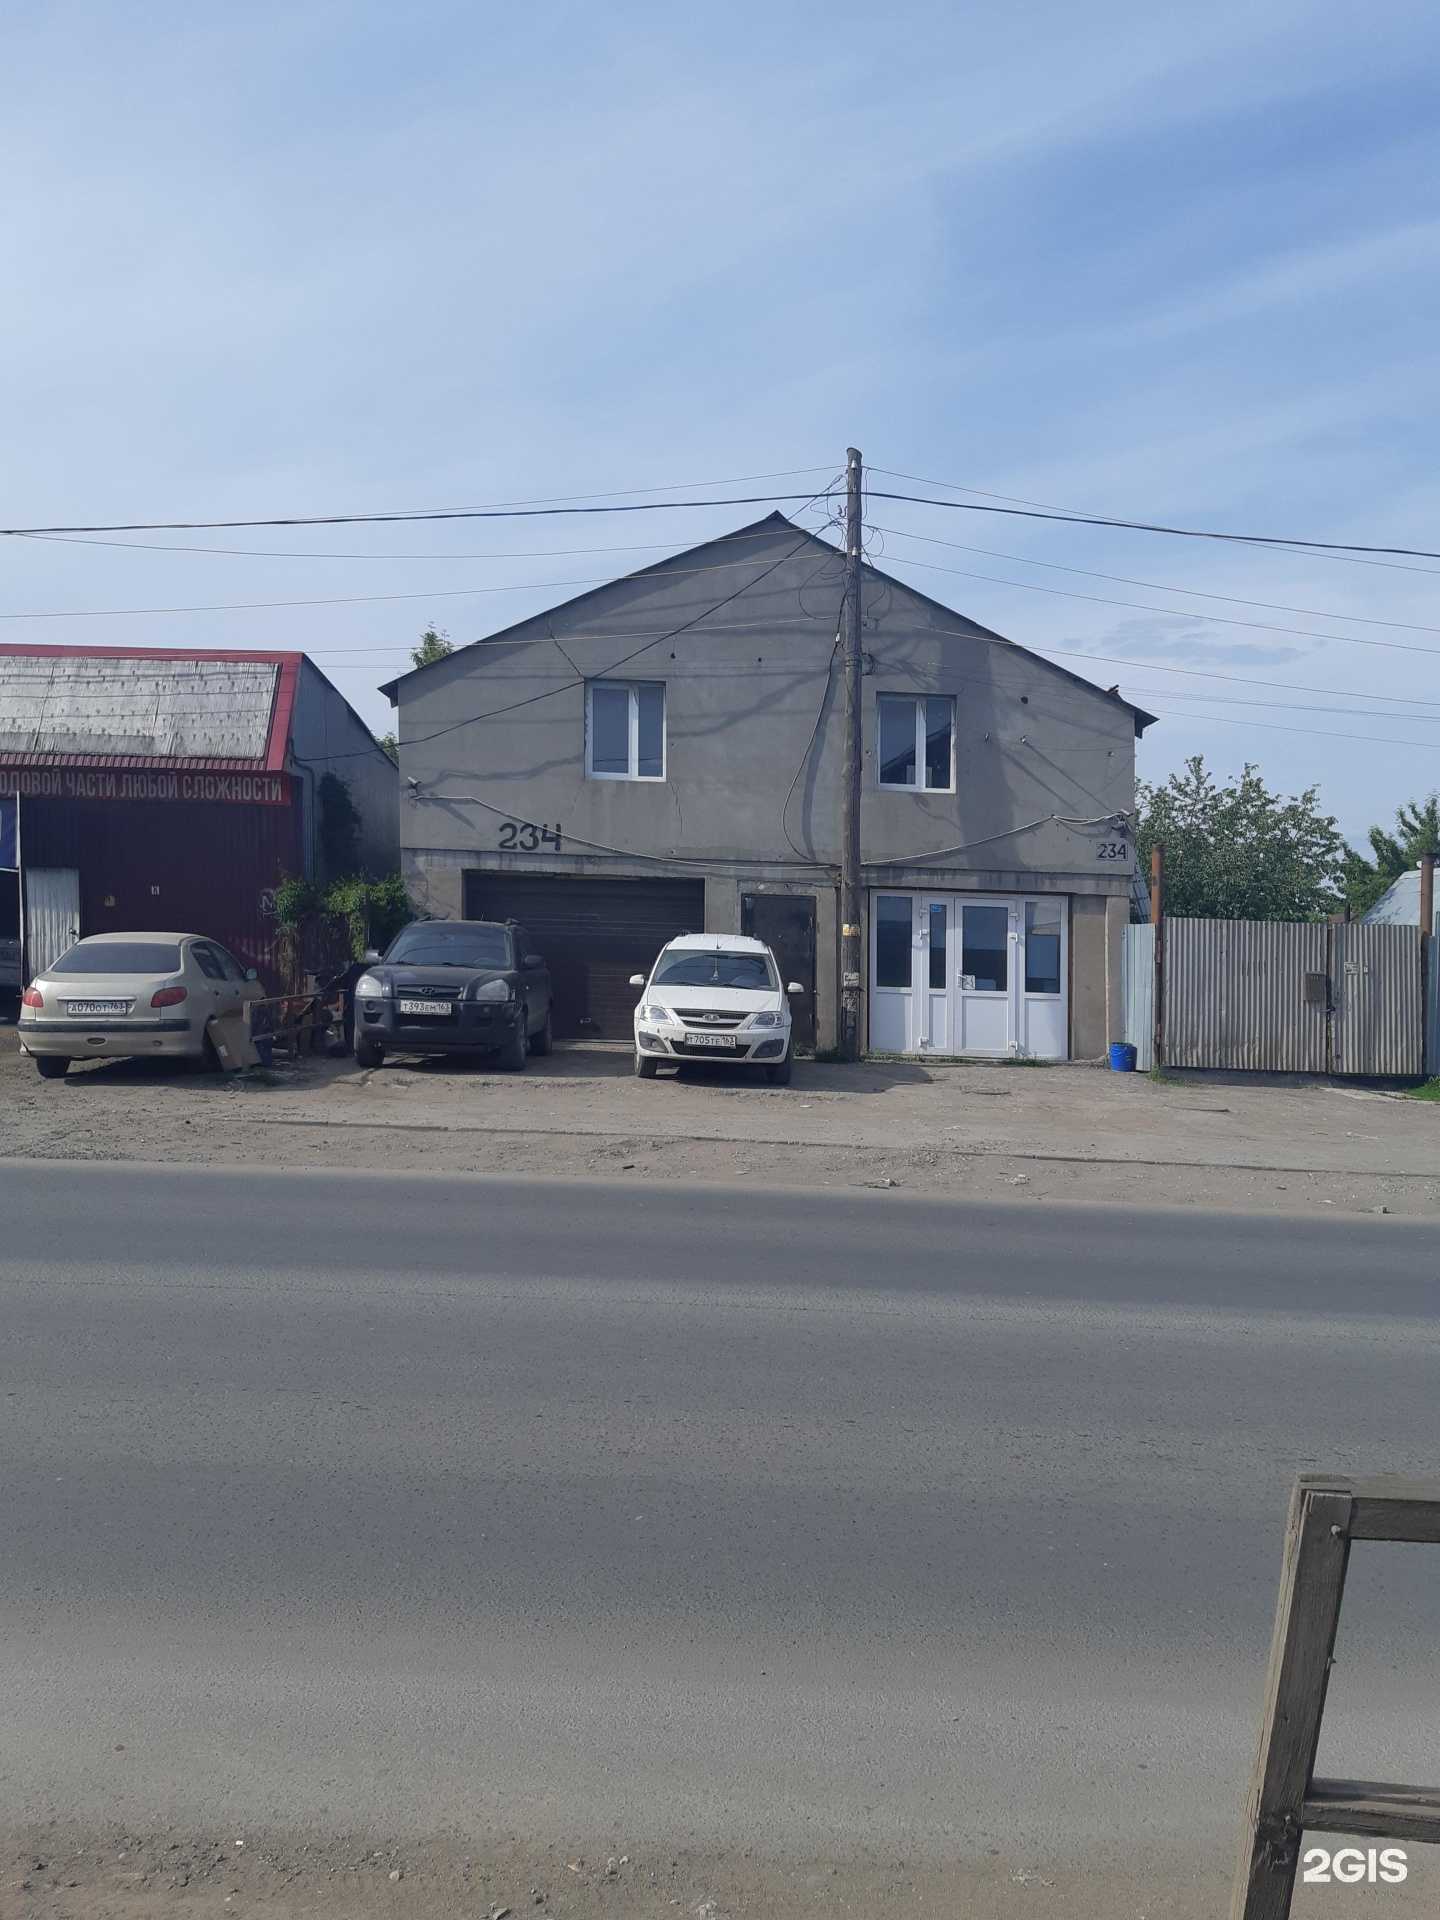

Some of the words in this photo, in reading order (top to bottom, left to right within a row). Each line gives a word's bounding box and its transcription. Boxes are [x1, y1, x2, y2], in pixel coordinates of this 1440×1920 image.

[66, 773, 116, 798] ЧАСТИ
[120, 770, 178, 799] ЛЮБОЙ
[182, 775, 282, 801] СЛОЖНОСТИ
[499, 823, 561, 851] 234
[1098, 843, 1126, 859] 234
